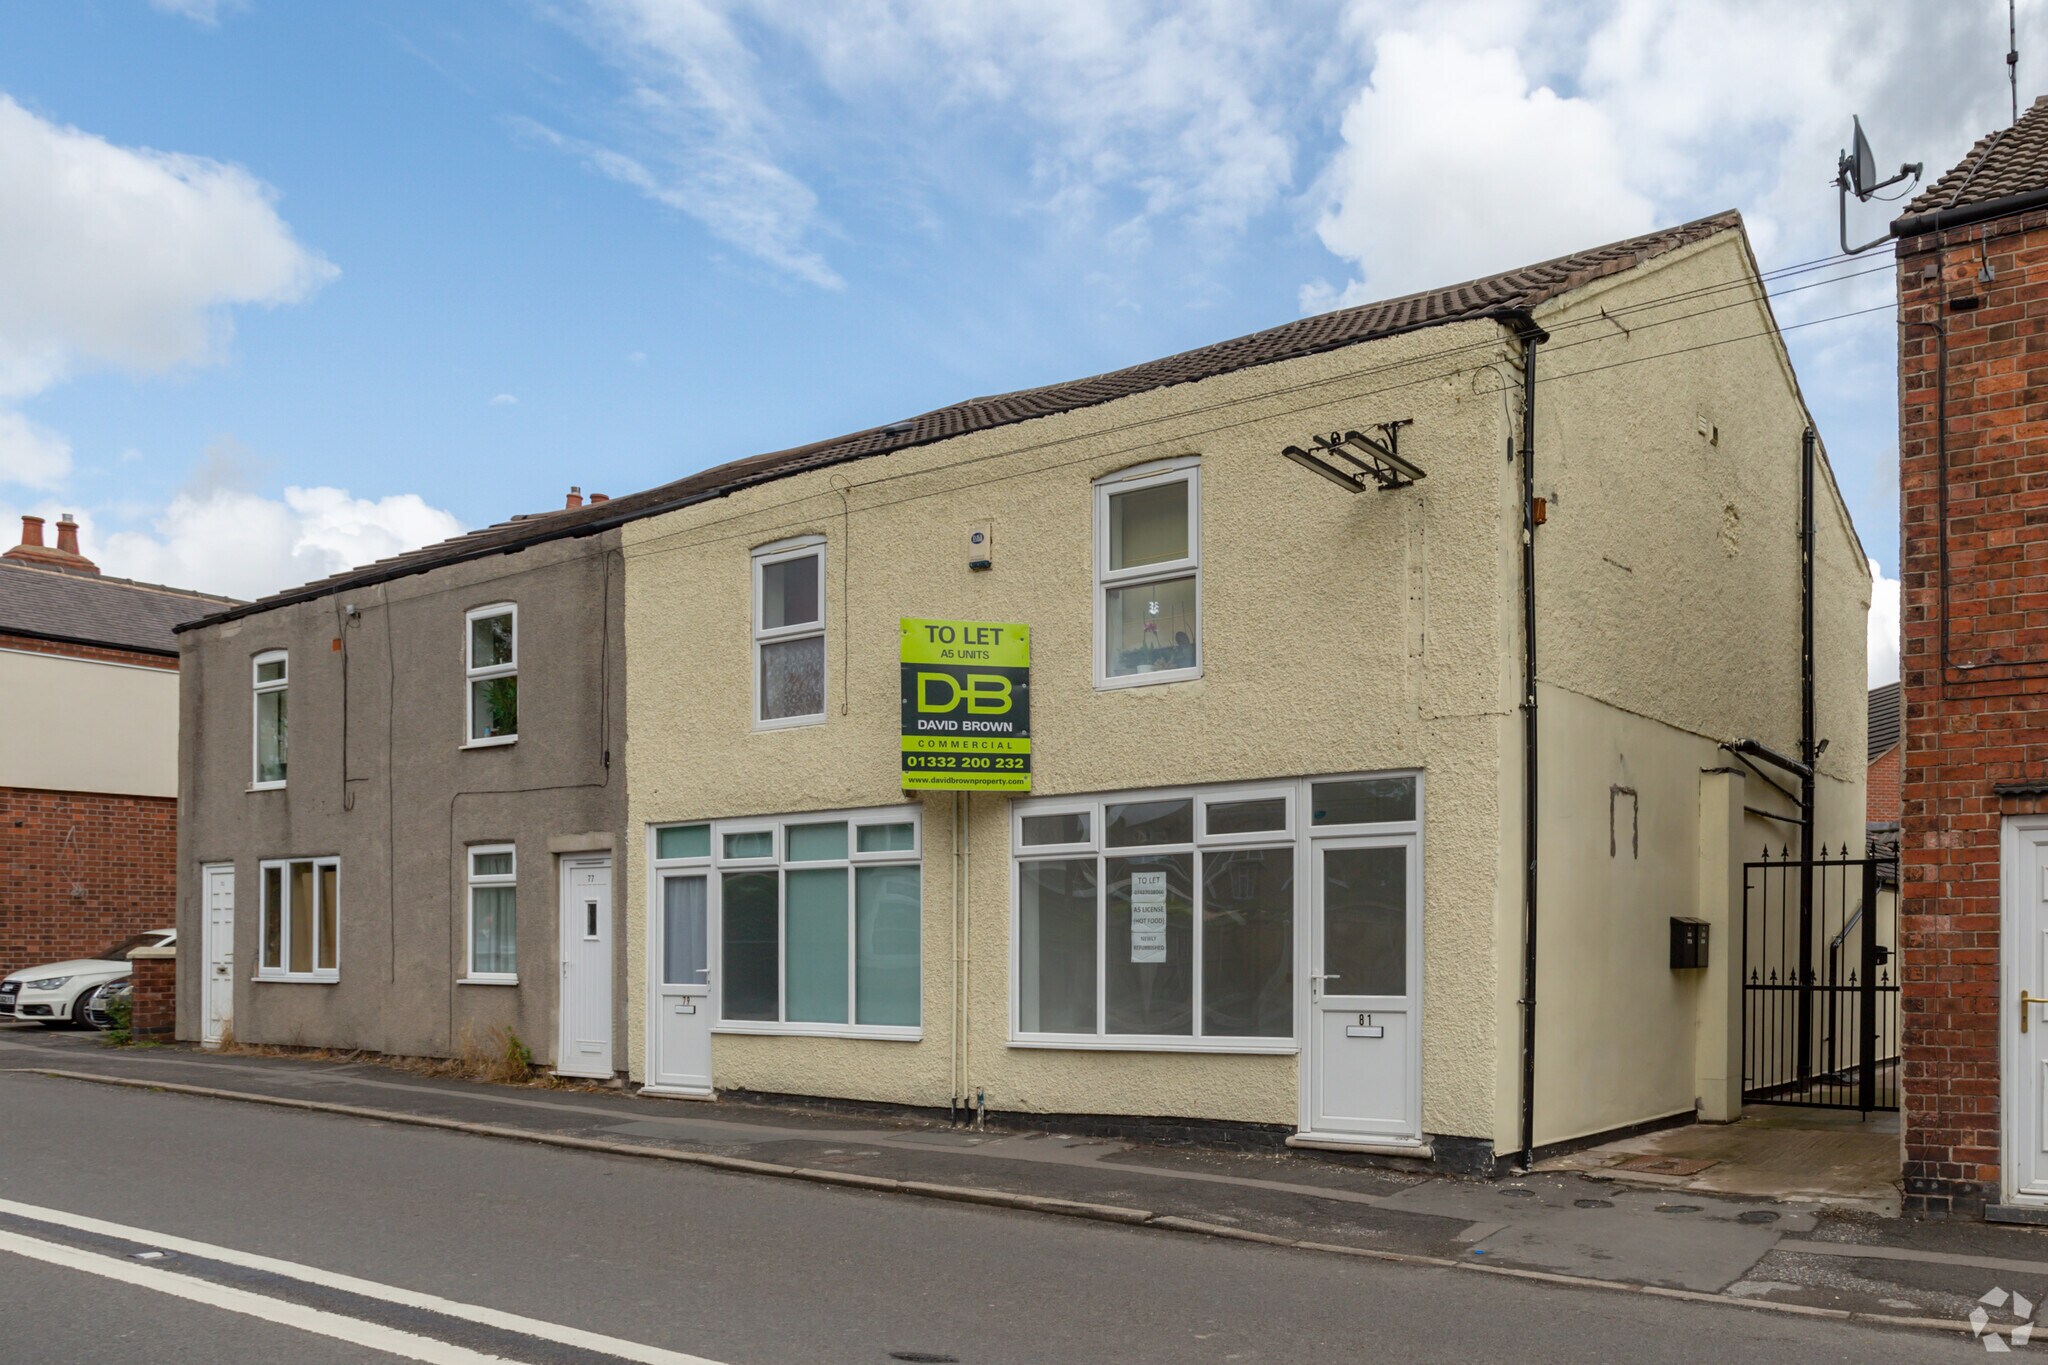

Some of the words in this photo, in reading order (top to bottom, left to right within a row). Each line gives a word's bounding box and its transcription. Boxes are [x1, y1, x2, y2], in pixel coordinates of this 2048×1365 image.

[925, 625, 955, 644] TO
[964, 627, 1004, 645] LET
[940, 649, 955, 659] A5
[957, 650, 990, 660] UNITS
[917, 719, 958, 731] DAVID
[962, 721, 1013, 732] BROWN
[918, 739, 1013, 750] COMMERCIAL
[907, 756, 957, 767] 01332
[961, 757, 990, 768] 200
[995, 758, 1024, 769] 232
[908, 776, 1025, 786] www.davidbrownproperty.com
[587, 874, 595, 883] 77
[1138, 876, 1147, 885] TO
[1149, 876, 1160, 885] LET
[1359, 1013, 1372, 1026] 81
